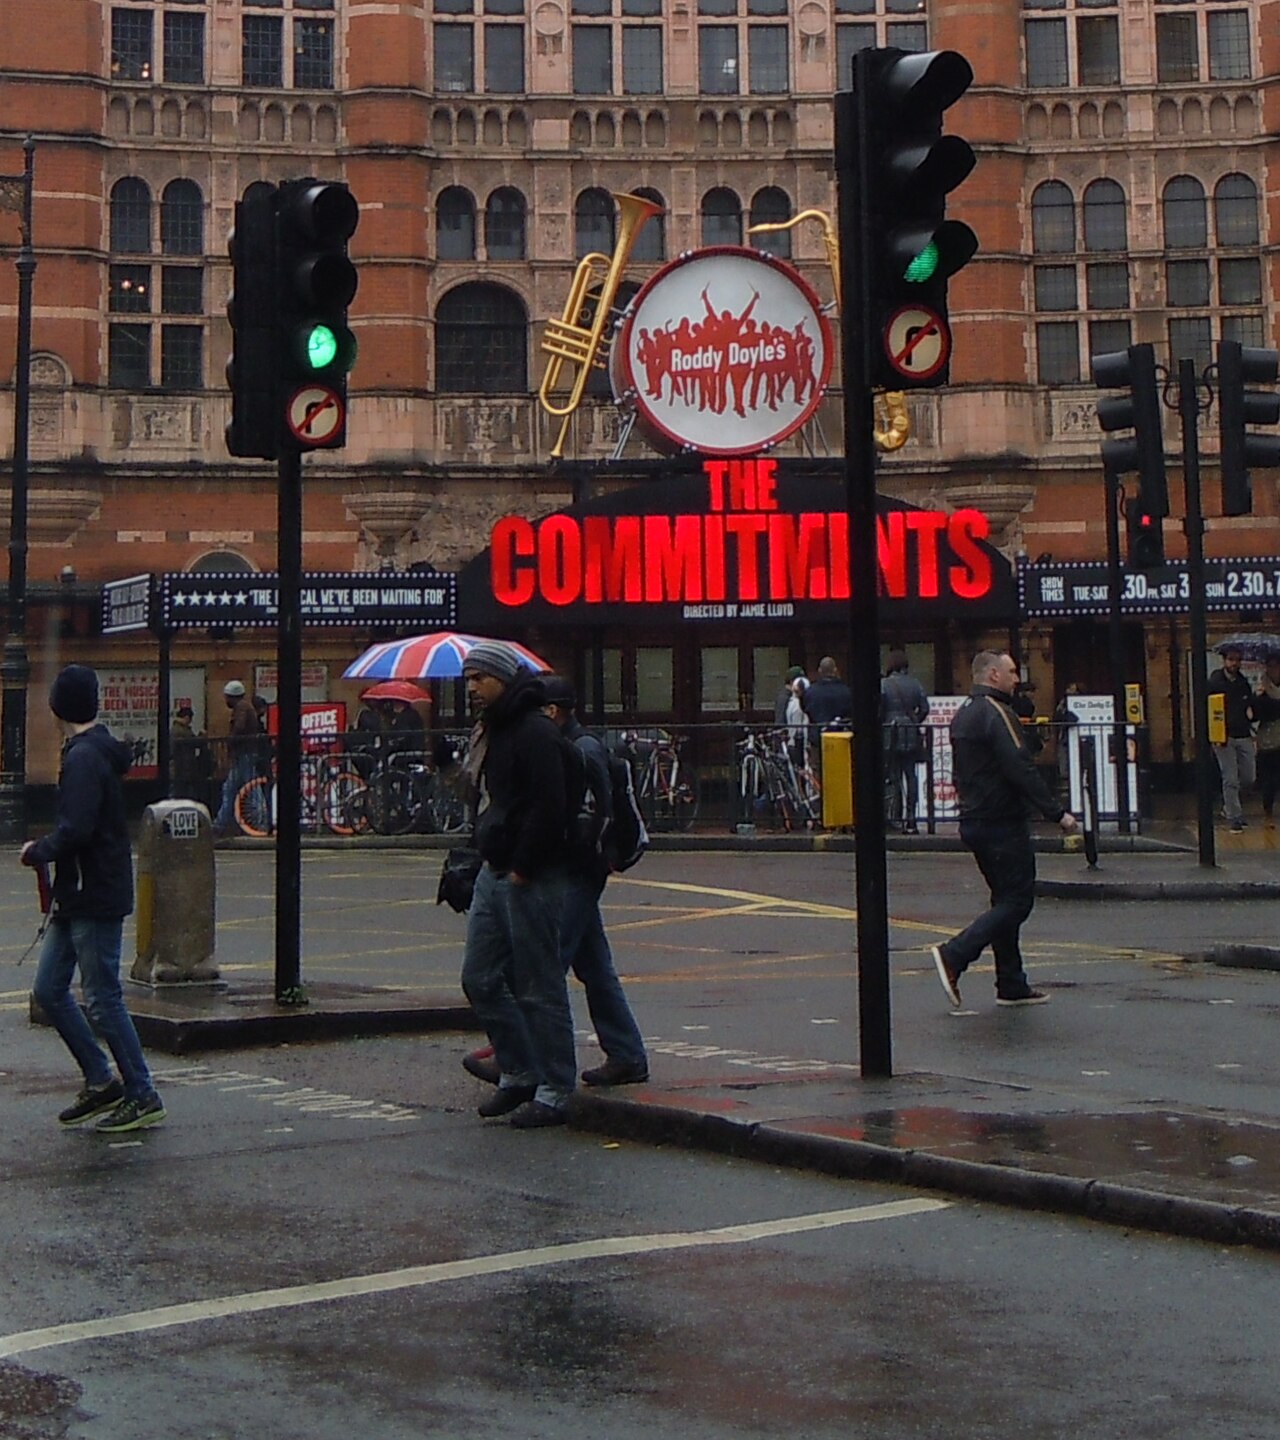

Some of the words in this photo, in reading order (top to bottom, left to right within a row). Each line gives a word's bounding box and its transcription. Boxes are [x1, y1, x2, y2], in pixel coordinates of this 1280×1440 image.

[671, 345, 723, 373] Roddy
[729, 335, 787, 369] Doyle's
[702, 459, 778, 511] THE
[1041, 576, 1064, 589] SHOW
[1073, 585, 1110, 601] TUE-SAT
[1160, 584, 1177, 599] SAT
[1205, 582, 1225, 598] SUN
[1227, 570, 1264, 597] 2.30
[321, 588, 351, 606] WE'VE
[352, 588, 379, 606] BEEN
[380, 587, 422, 606] WAITING
[424, 587, 446, 605] FOR'
[1041, 588, 1065, 602] TIMES
[683, 603, 725, 619] DIRECTED
[726, 603, 738, 618] BY
[740, 602, 766, 618] JAMIE
[767, 602, 794, 618] LLOYD
[125, 686, 160, 698] MUSICA
[104, 698, 128, 710] BEEN
[302, 709, 337, 730] OFFICE
[173, 812, 197, 828] LOVE
[173, 828, 197, 837] ME
